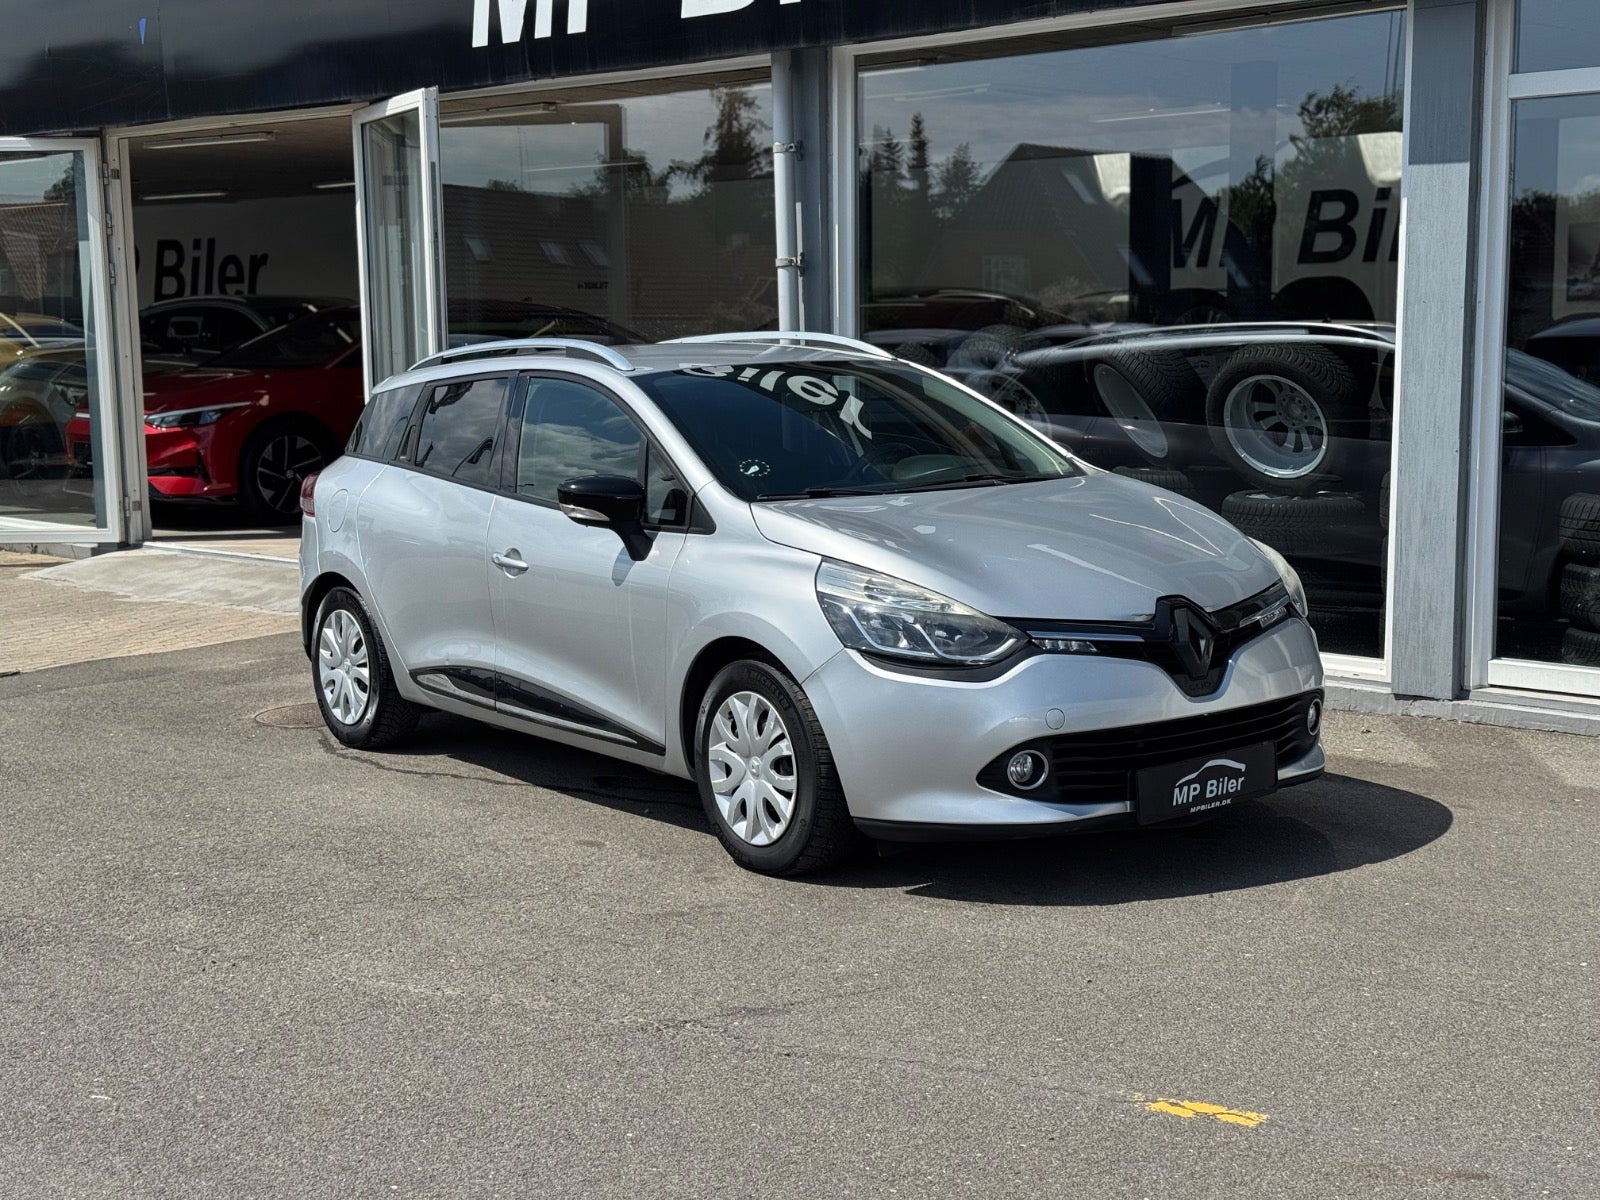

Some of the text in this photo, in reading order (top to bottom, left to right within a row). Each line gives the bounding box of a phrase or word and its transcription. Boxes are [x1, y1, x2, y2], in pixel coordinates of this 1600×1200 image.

[154, 238, 269, 302] Biler
[1172, 776, 1245, 806] MP Biler
[1190, 798, 1232, 813] MPBILER.DK
